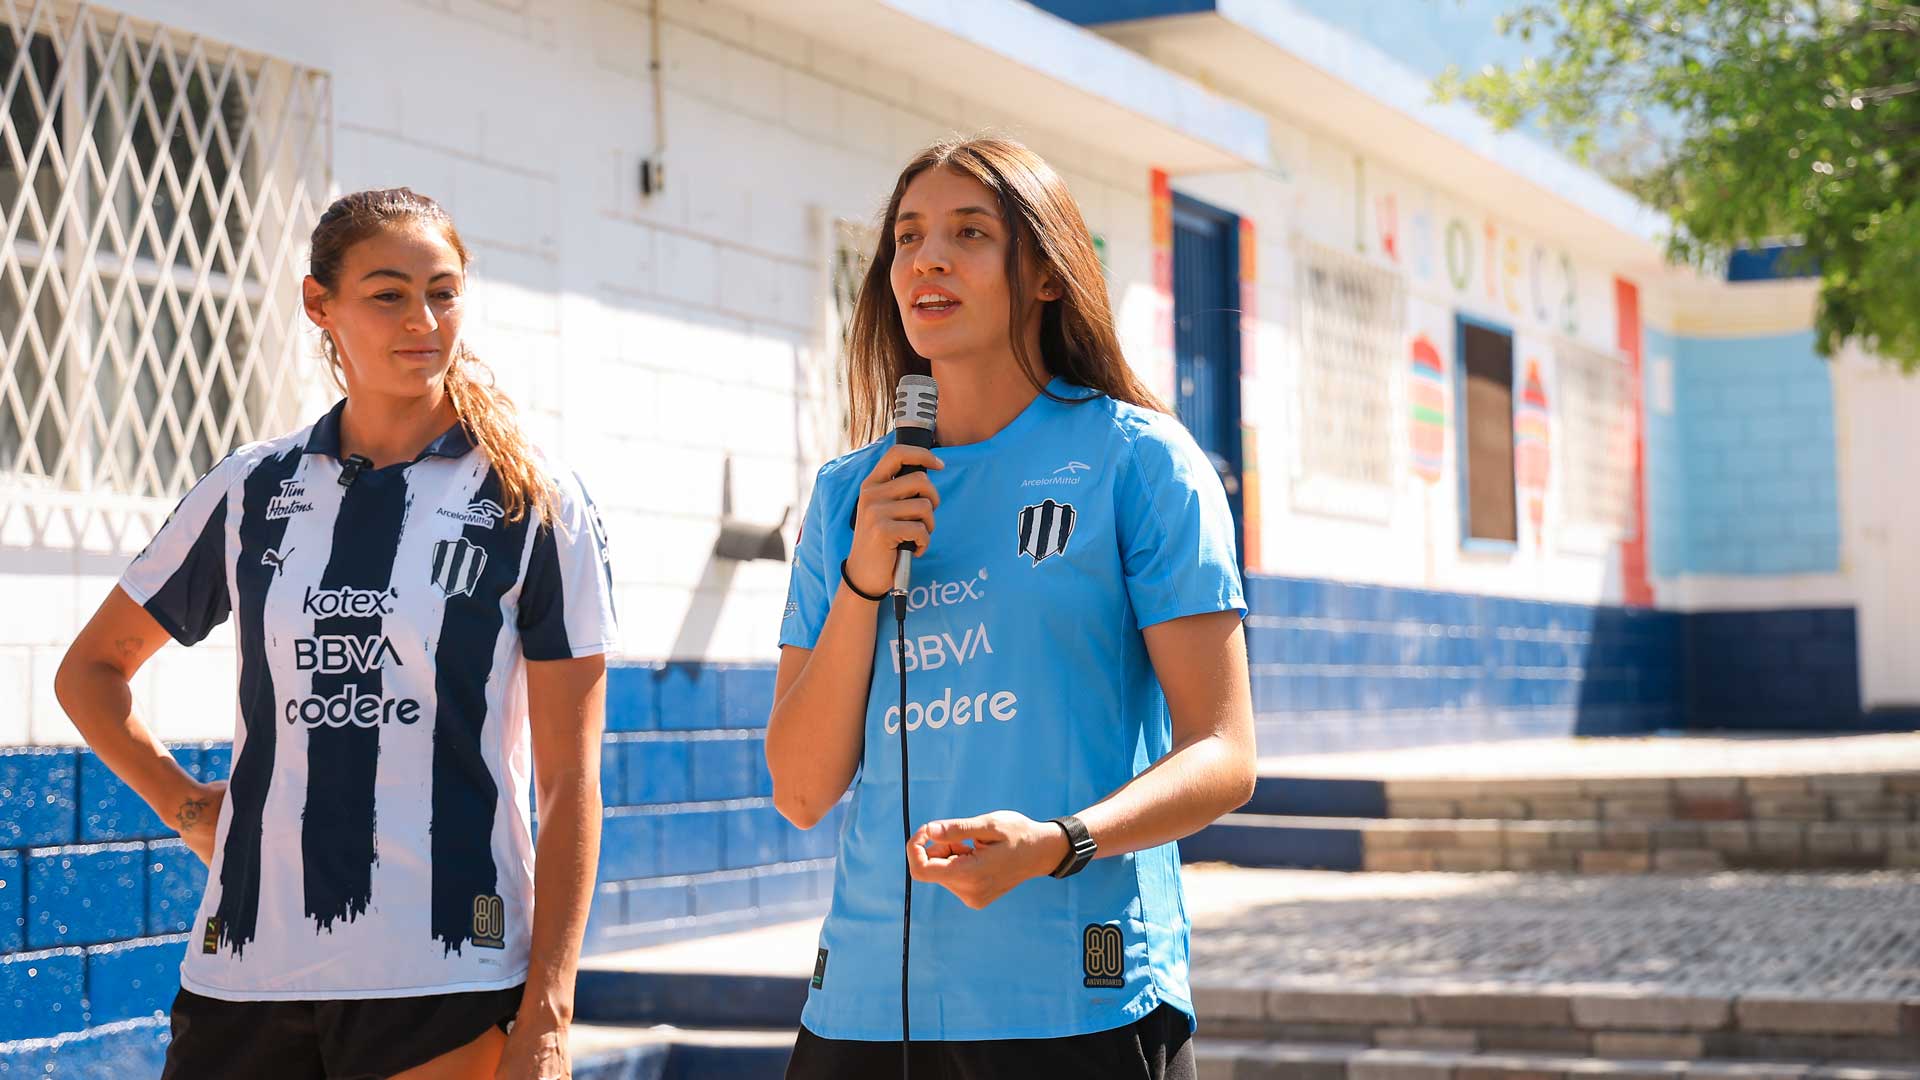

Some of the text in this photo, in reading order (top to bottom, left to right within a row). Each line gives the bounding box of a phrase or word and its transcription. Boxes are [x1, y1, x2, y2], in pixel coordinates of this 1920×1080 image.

[282, 480, 306, 499] Tim
[1020, 475, 1081, 488] ArcelorMittal
[436, 507, 493, 526] ArcelorMittal
[302, 585, 389, 616] kotex
[893, 578, 979, 613] otex
[294, 635, 404, 671] BBVA
[889, 621, 994, 675] BBVA
[285, 686, 421, 725] codere
[884, 687, 1018, 736] codere
[474, 895, 503, 939] 80
[1086, 926, 1122, 977] 80
